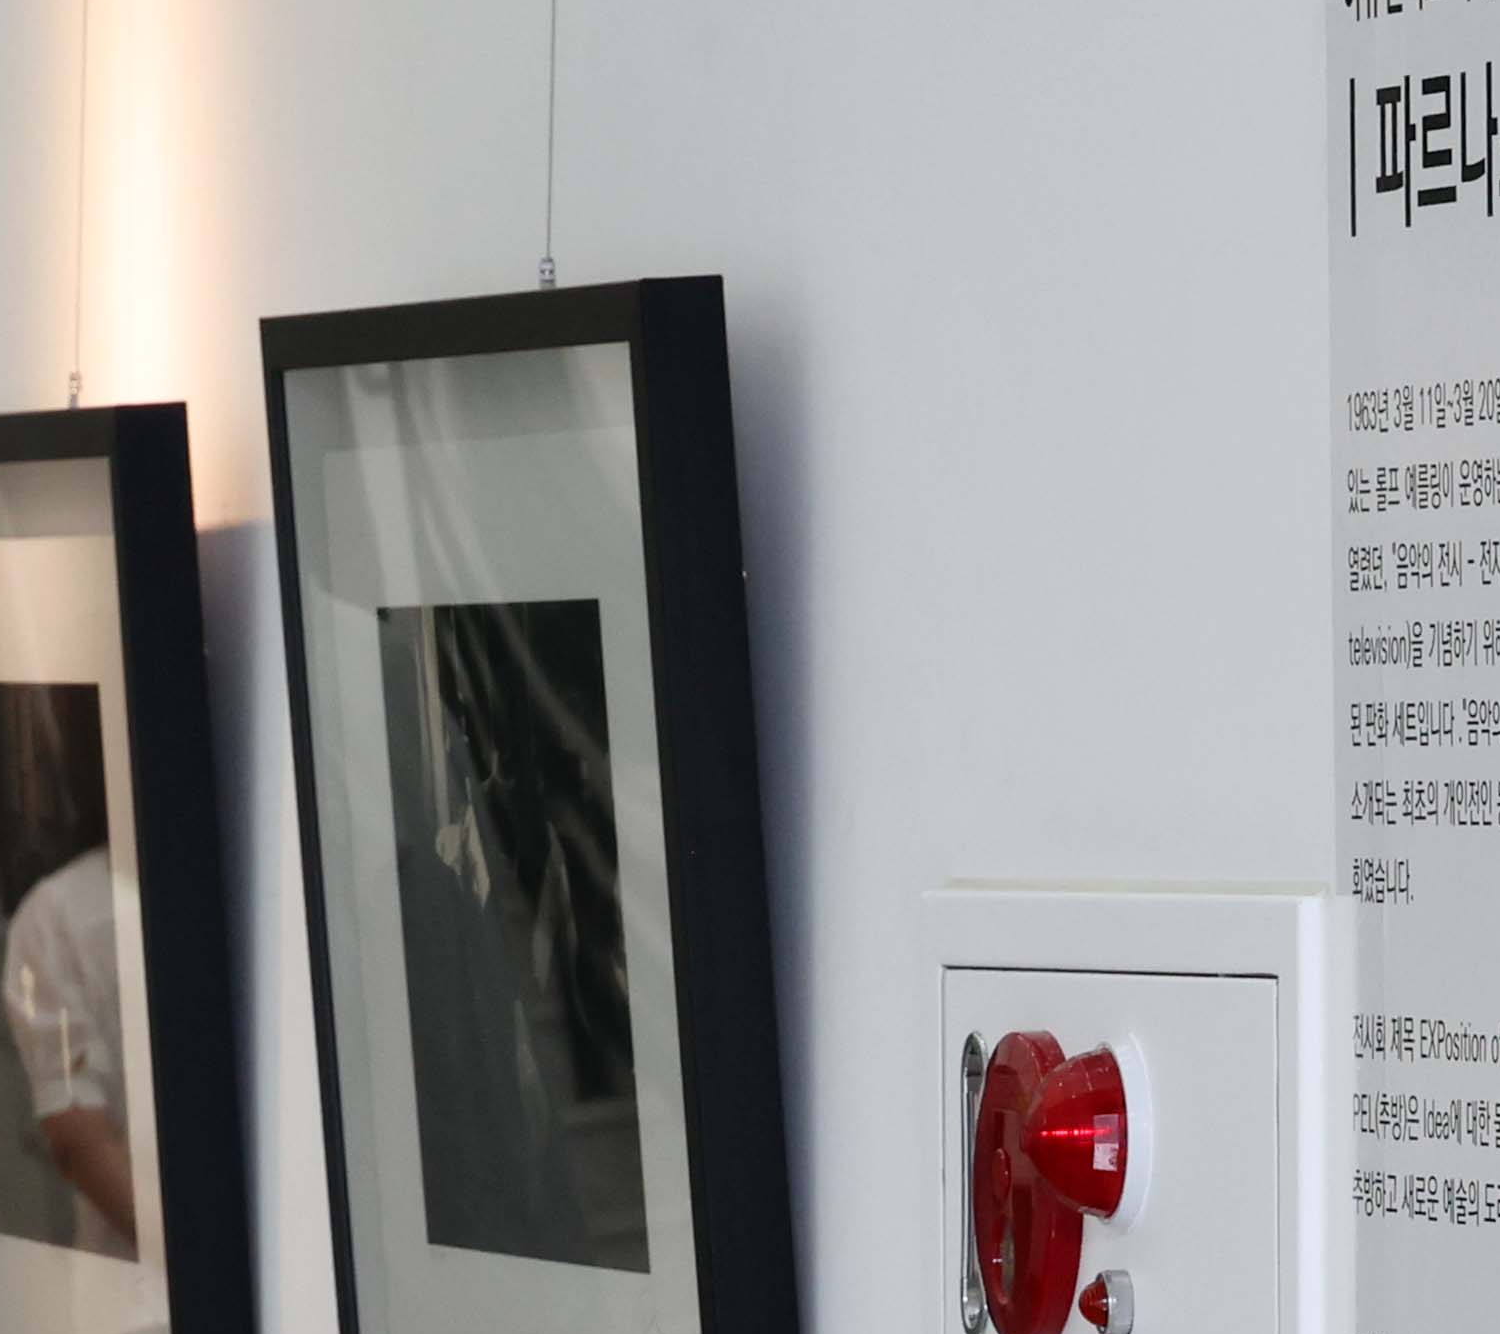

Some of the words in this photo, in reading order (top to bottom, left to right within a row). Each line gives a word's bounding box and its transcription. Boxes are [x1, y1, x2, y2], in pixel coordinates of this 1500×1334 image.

[1347, 388, 1389, 433] 1963년
[1393, 385, 1414, 431] 3월
[1347, 469, 1371, 513] 있는
[1375, 467, 1400, 512] 롤프
[1438, 541, 1462, 587] 전시
[1428, 620, 1477, 667] 기념하기
[1351, 780, 1398, 825] 소개되는
[1402, 780, 1439, 826] 최초의
[1443, 780, 1493, 826] 개인전인
[1390, 1016, 1416, 1063] 제목
[1420, 1019, 1487, 1063] EXPosition
[1423, 1099, 1462, 1145] Idea에
[1466, 1100, 1491, 1147] 대한
[1352, 1169, 1398, 1217] 추방하고
[1401, 1175, 1440, 1222] 새로운
[1443, 1179, 1480, 1227] 예술의
